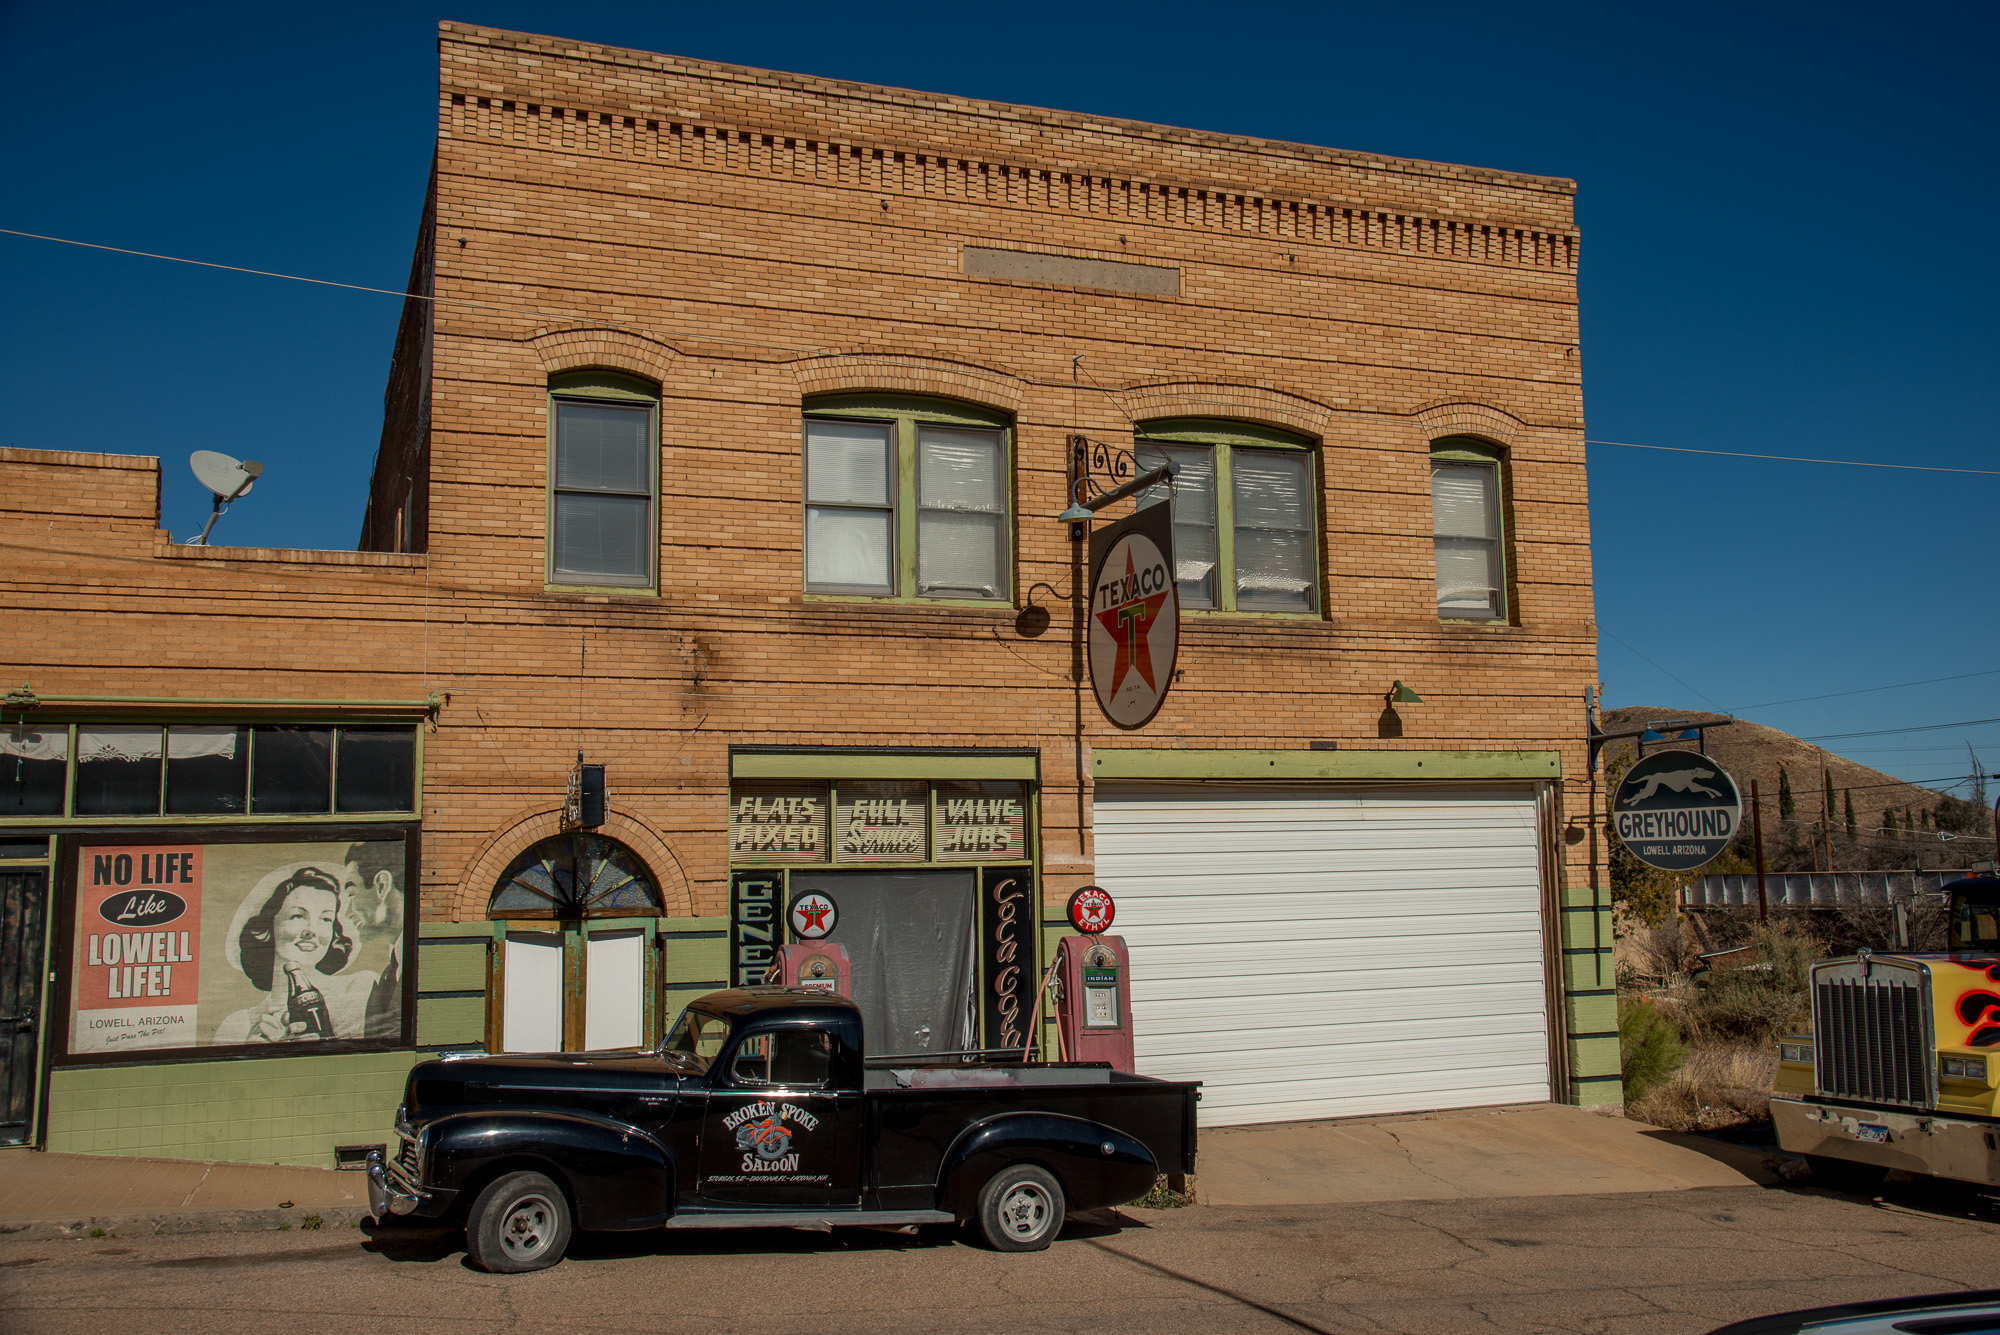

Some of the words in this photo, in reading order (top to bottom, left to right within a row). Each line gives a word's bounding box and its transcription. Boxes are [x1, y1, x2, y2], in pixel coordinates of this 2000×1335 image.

[1100, 563, 1165, 609] TEXACO
[738, 797, 817, 816] FLATS
[852, 799, 913, 818] FULL
[947, 799, 1016, 817] VALVE
[847, 820, 922, 845] Service
[1618, 809, 1732, 839] GREYHOUND
[737, 825, 819, 843] FIXED
[946, 826, 1013, 844] JOBS
[1643, 845, 1671, 856] LOWELL
[1672, 845, 1707, 856] ARIZONA
[93, 853, 133, 886] NO
[140, 852, 194, 885] LIFE
[116, 893, 167, 921] Like
[1074, 890, 1111, 906] TEXACO
[993, 878, 1024, 963] Coca
[1078, 918, 1110, 931] ETHYL
[88, 931, 193, 966] LOWELL
[107, 965, 172, 999] LIFE!
[89, 1018, 136, 1029] LOWELL,
[138, 1015, 185, 1027] ARIZONA
[105, 1036, 119, 1046] Just
[121, 1033, 137, 1041] Pass
[138, 1030, 150, 1038] The
[722, 1101, 776, 1131] BROKEN
[781, 1102, 819, 1132] SPOKE
[741, 1152, 800, 1172] SALOON
